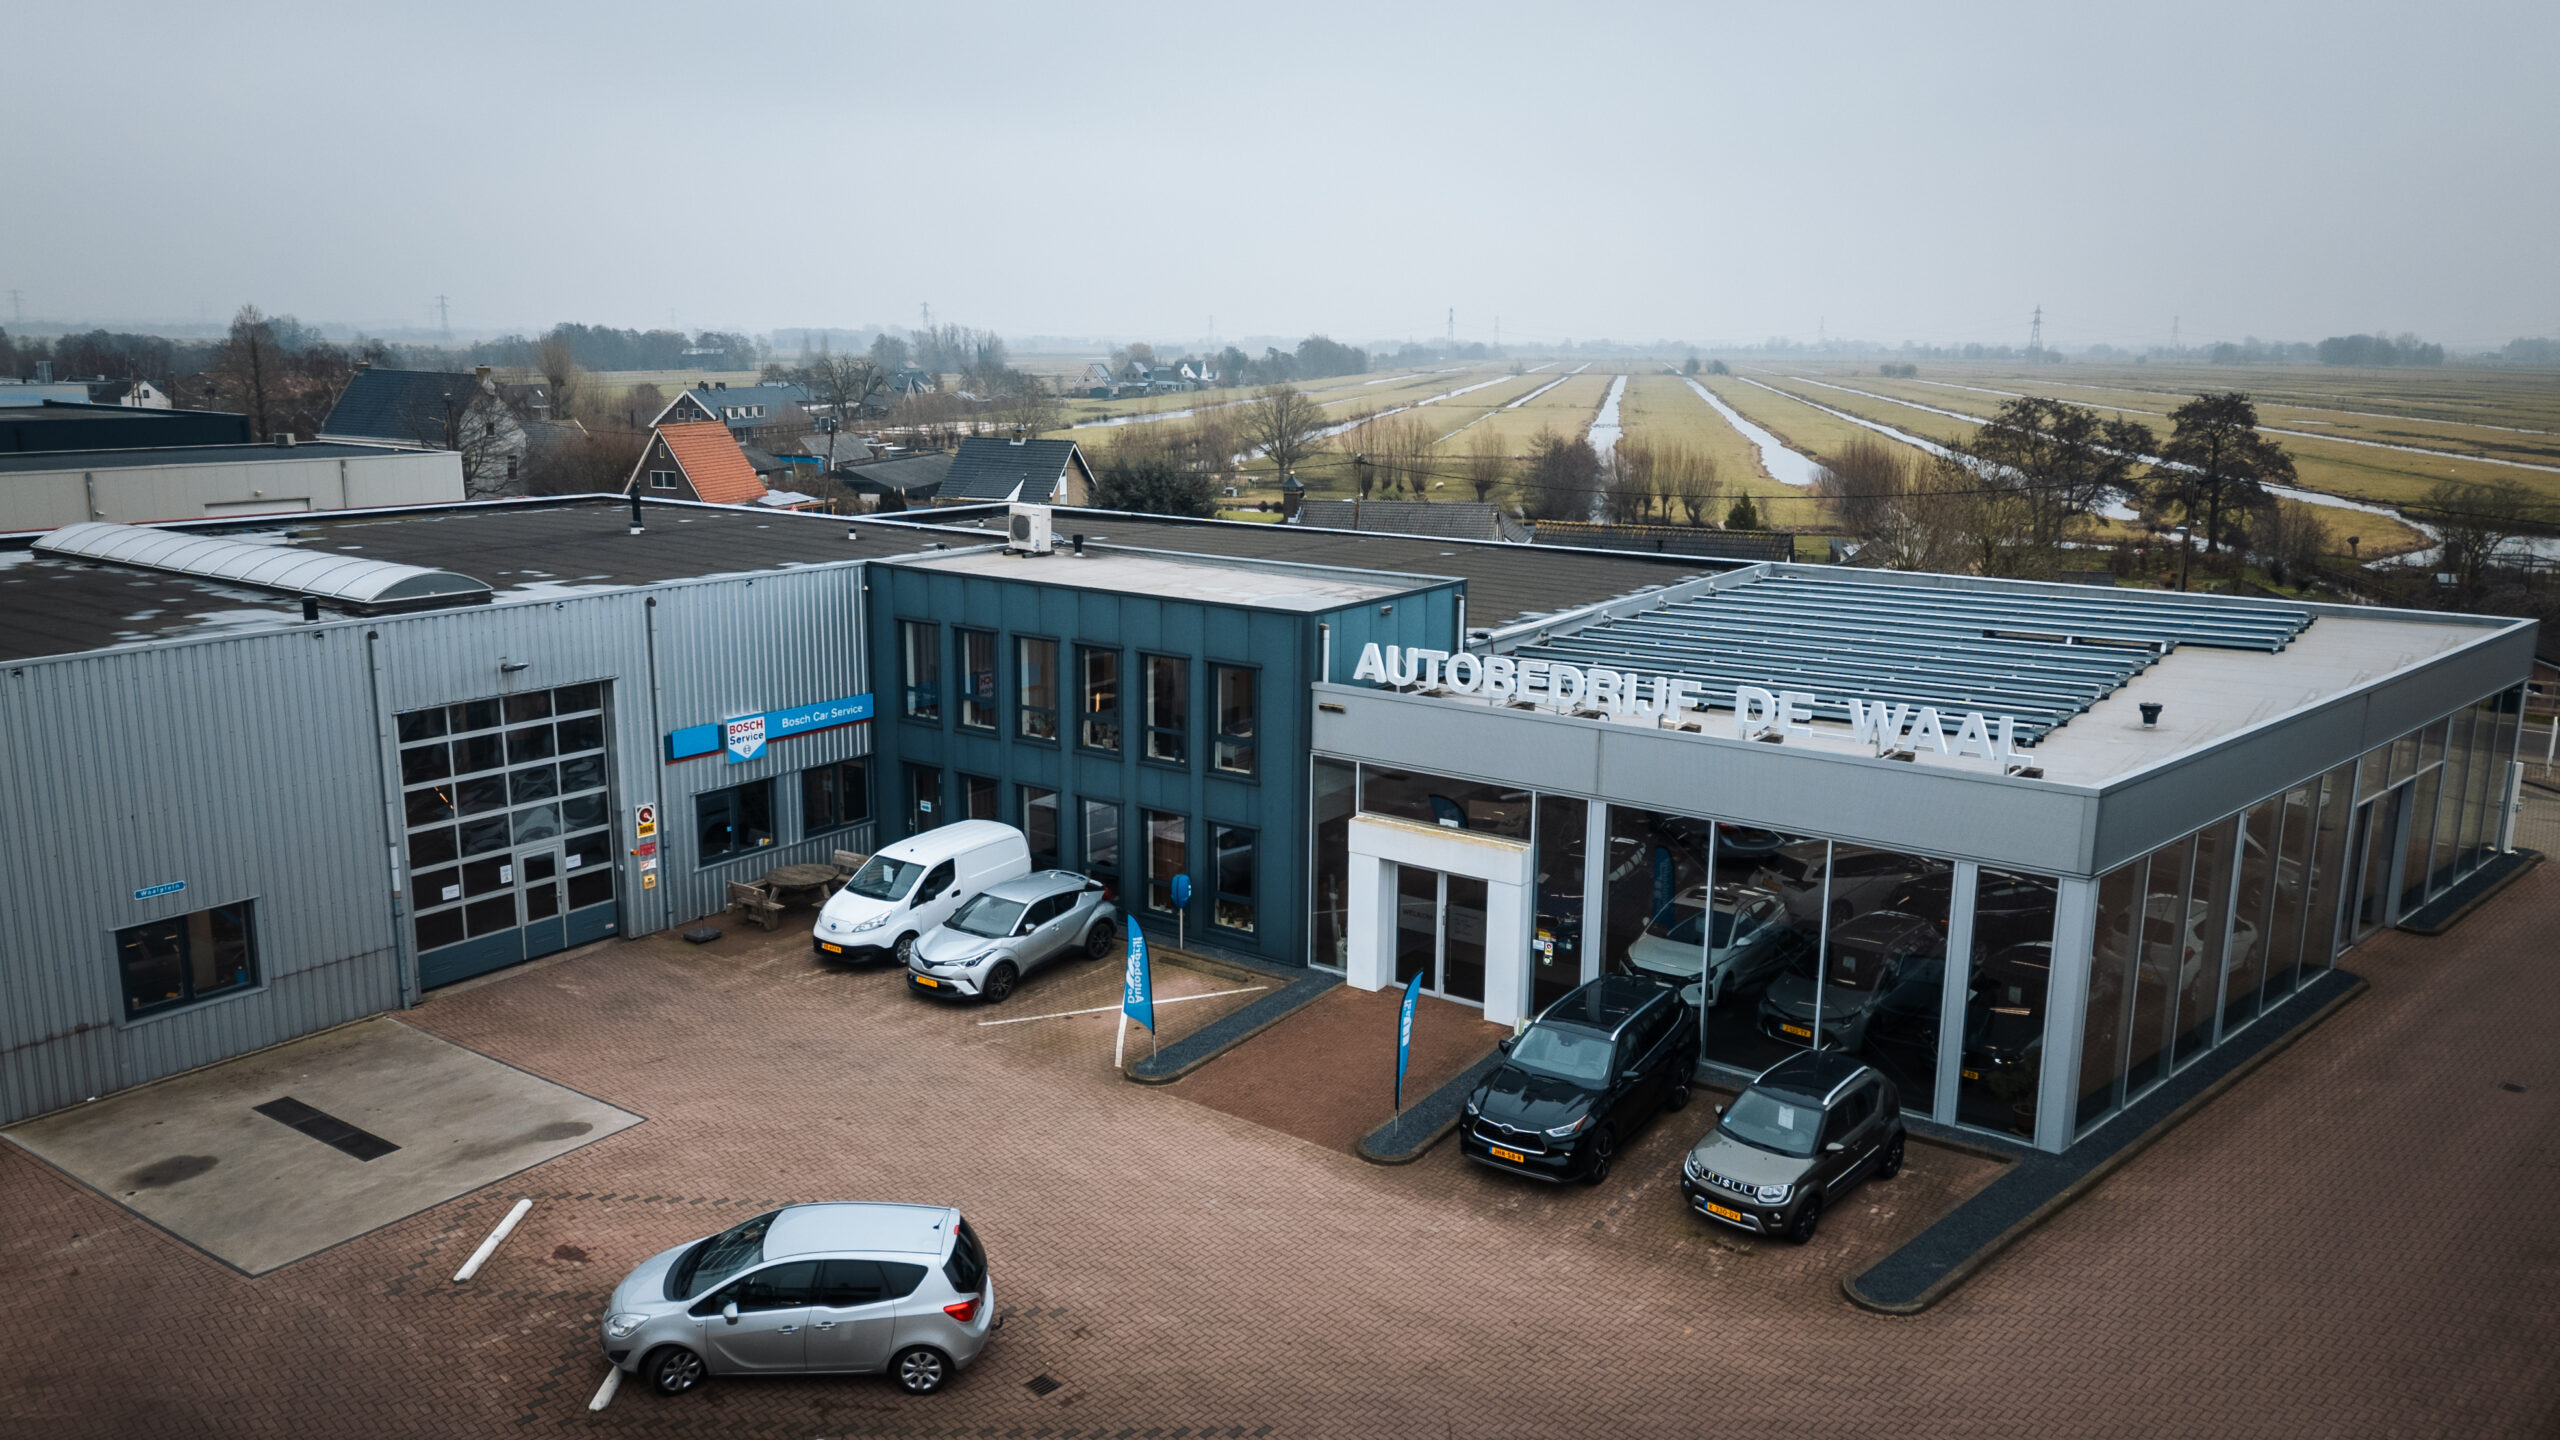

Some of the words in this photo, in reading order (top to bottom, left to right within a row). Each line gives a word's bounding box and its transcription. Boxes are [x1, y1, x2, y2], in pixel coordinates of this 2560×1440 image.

[1353, 643, 1702, 722] AUTOBEDRIJF
[1734, 685, 1815, 737] DE
[1849, 699, 2034, 768] WAAL
[782, 715, 811, 728] Bosch
[813, 711, 828, 722] Car
[831, 704, 863, 718] Service
[729, 719, 763, 735] BOSCH
[729, 731, 764, 746] Service
